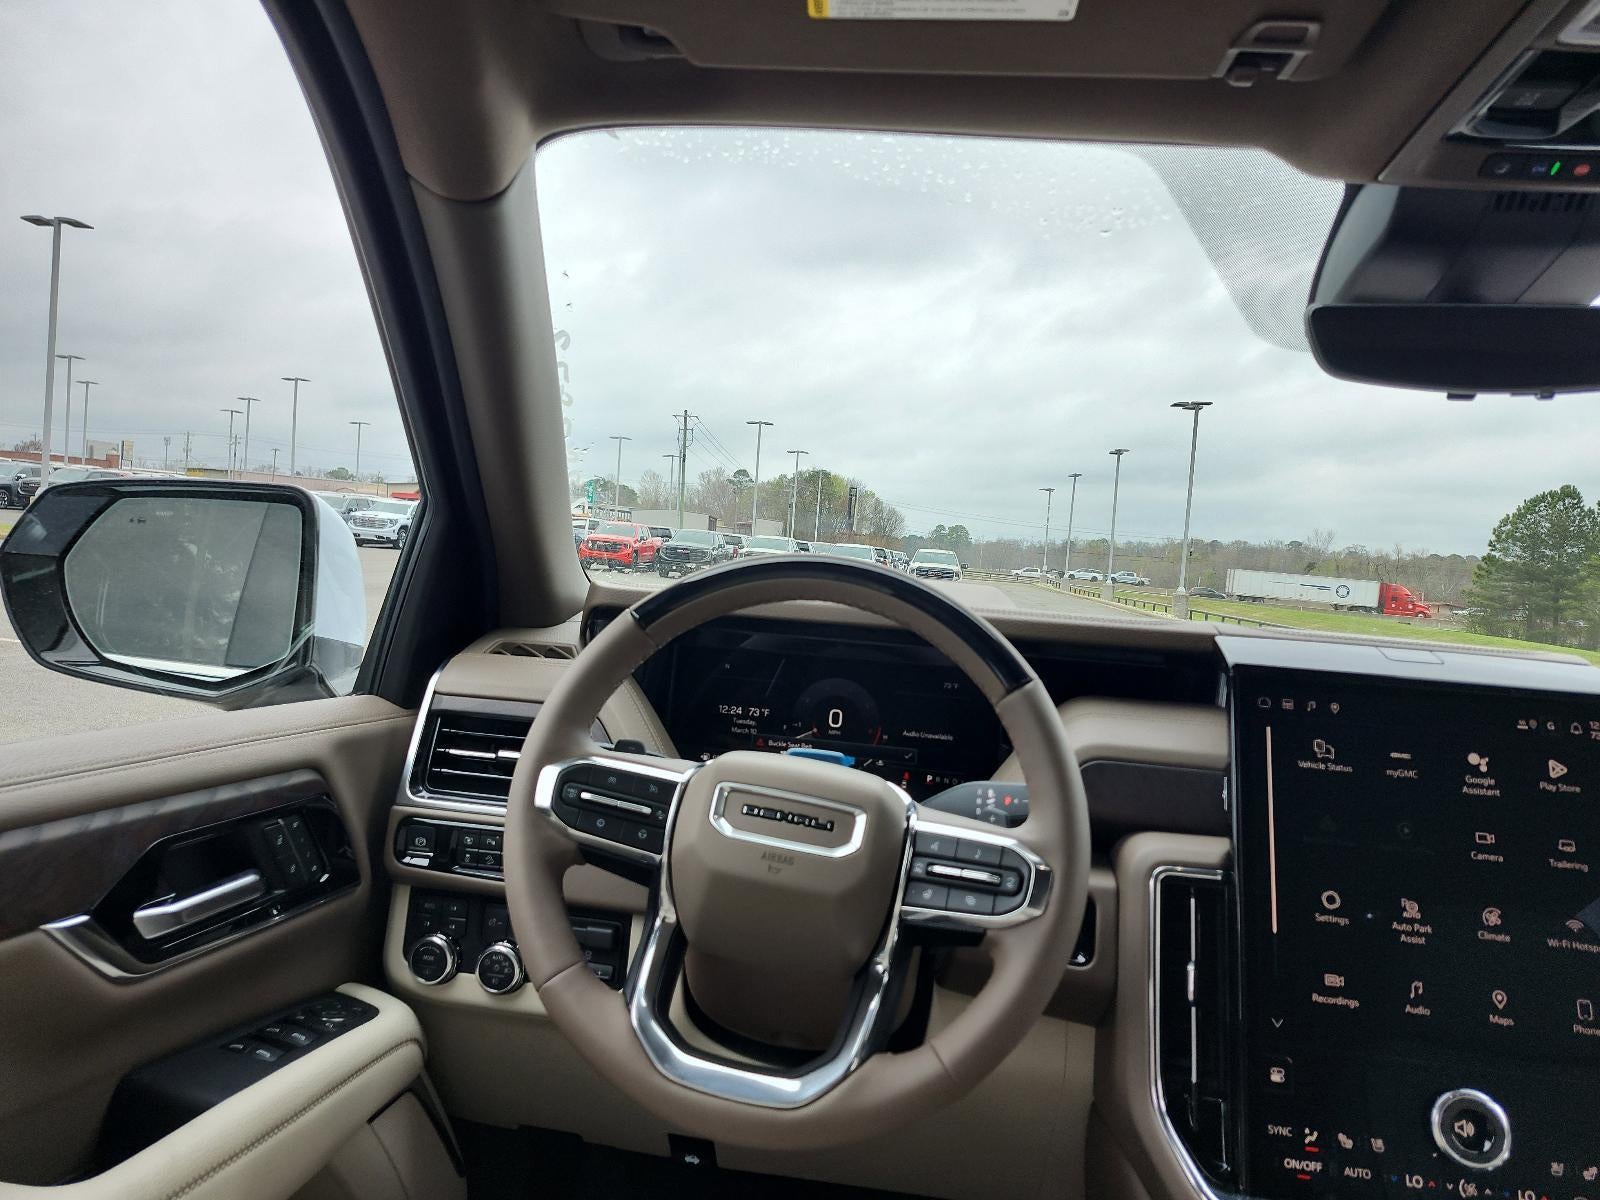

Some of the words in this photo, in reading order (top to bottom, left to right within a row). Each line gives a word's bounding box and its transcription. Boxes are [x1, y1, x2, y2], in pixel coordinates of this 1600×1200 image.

[719, 704, 742, 714] 12:24
[748, 707, 760, 717] 73
[828, 708, 843, 728] 0
[731, 726, 749, 734] March
[1298, 760, 1326, 770] Vehicle
[1327, 762, 1353, 772] Status
[1386, 769, 1418, 779] myGMC
[1465, 775, 1496, 787] Google
[1540, 780, 1557, 792] Play
[1558, 784, 1581, 793] Store
[1462, 785, 1500, 797] Assistant
[1471, 851, 1504, 862] Camera
[1315, 912, 1350, 926] Settings
[1392, 921, 1413, 932] Auto
[1414, 922, 1433, 934] Park
[1401, 934, 1426, 945] Assist
[1478, 930, 1511, 942] Climate
[1547, 938, 1571, 949] Wi-Fi
[1311, 992, 1360, 1009] Recordings
[1405, 1004, 1431, 1016] Audio
[1489, 1014, 1515, 1026] Maps
[1267, 1125, 1293, 1138] SYNC
[1283, 1157, 1323, 1173] ON/OFF
[1344, 1166, 1372, 1180] AUTO
[1405, 1173, 1424, 1189] LO
